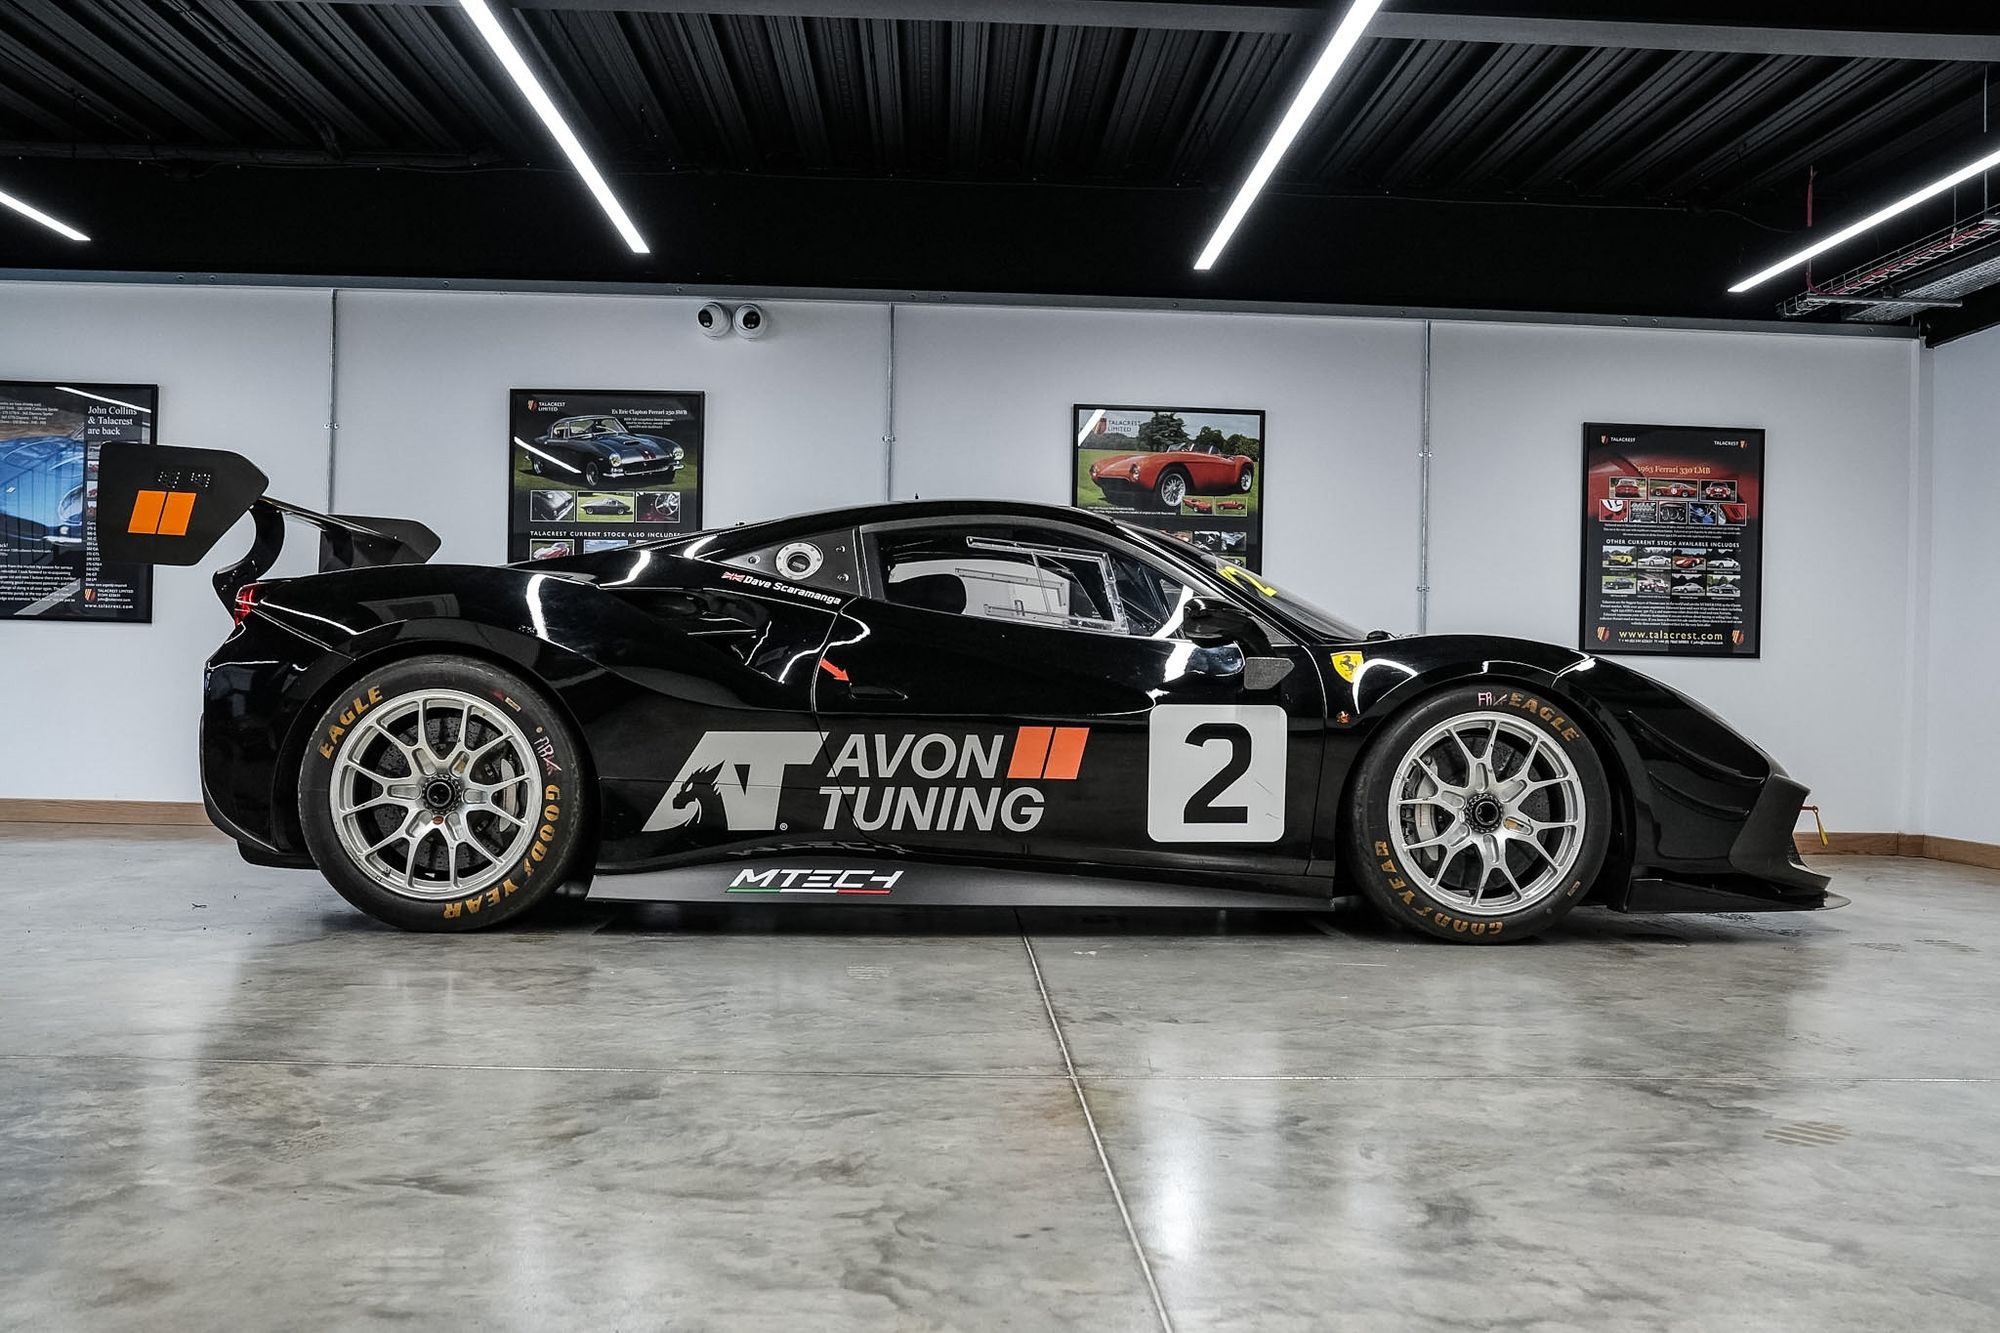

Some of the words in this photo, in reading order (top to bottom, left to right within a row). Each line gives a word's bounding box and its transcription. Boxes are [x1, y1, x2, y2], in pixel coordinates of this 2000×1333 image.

[88, 406, 107, 414] John
[109, 406, 138, 415] Collins
[88, 416, 96, 424] &
[98, 416, 133, 425] Talacrest
[102, 426, 121, 435] back
[1655, 465, 1679, 473] Ferrari
[743, 576, 773, 588] Dave
[773, 582, 842, 605] Scaramanga
[1618, 630, 1723, 641] www.talacrest.com
[319, 685, 384, 760] EAGLE
[1510, 692, 1581, 742] EAGLE
[826, 733, 1005, 779] AVON
[1181, 722, 1253, 825] 2
[819, 786, 1046, 833] TUNING
[729, 869, 904, 889] MTECH
